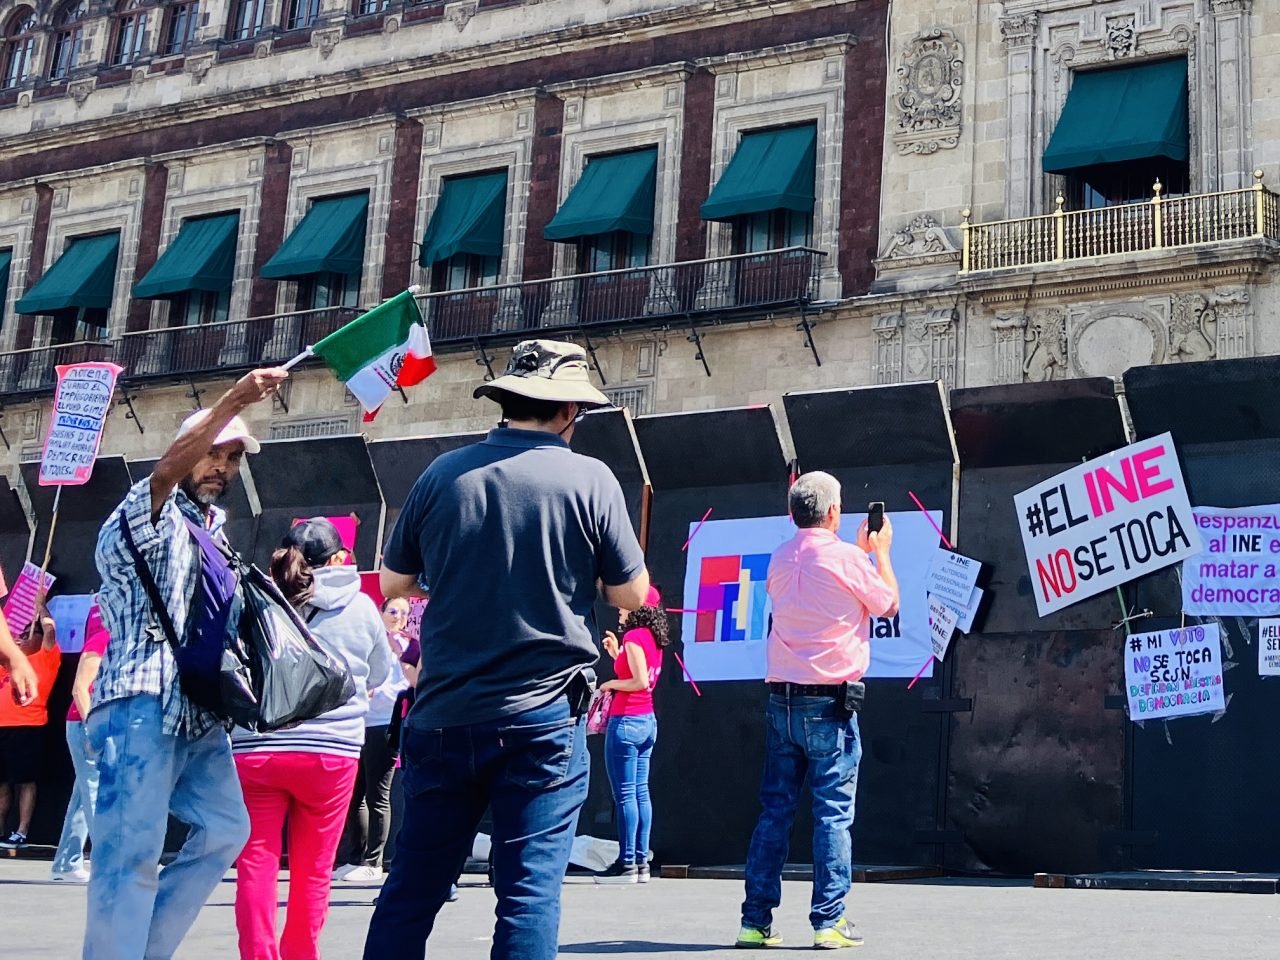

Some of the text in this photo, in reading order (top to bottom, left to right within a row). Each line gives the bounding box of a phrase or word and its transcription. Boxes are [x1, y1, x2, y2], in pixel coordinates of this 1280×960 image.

[1209, 534, 1226, 553] al
[1232, 534, 1262, 553] INE
[1199, 559, 1259, 579] matar
[1264, 563, 1276, 578] a
[932, 623, 949, 640] INE
[1169, 626, 1205, 646] VOTO
[1134, 647, 1212, 673] NO SE TOCA
[1138, 689, 1211, 713] DEMOCRACIA
